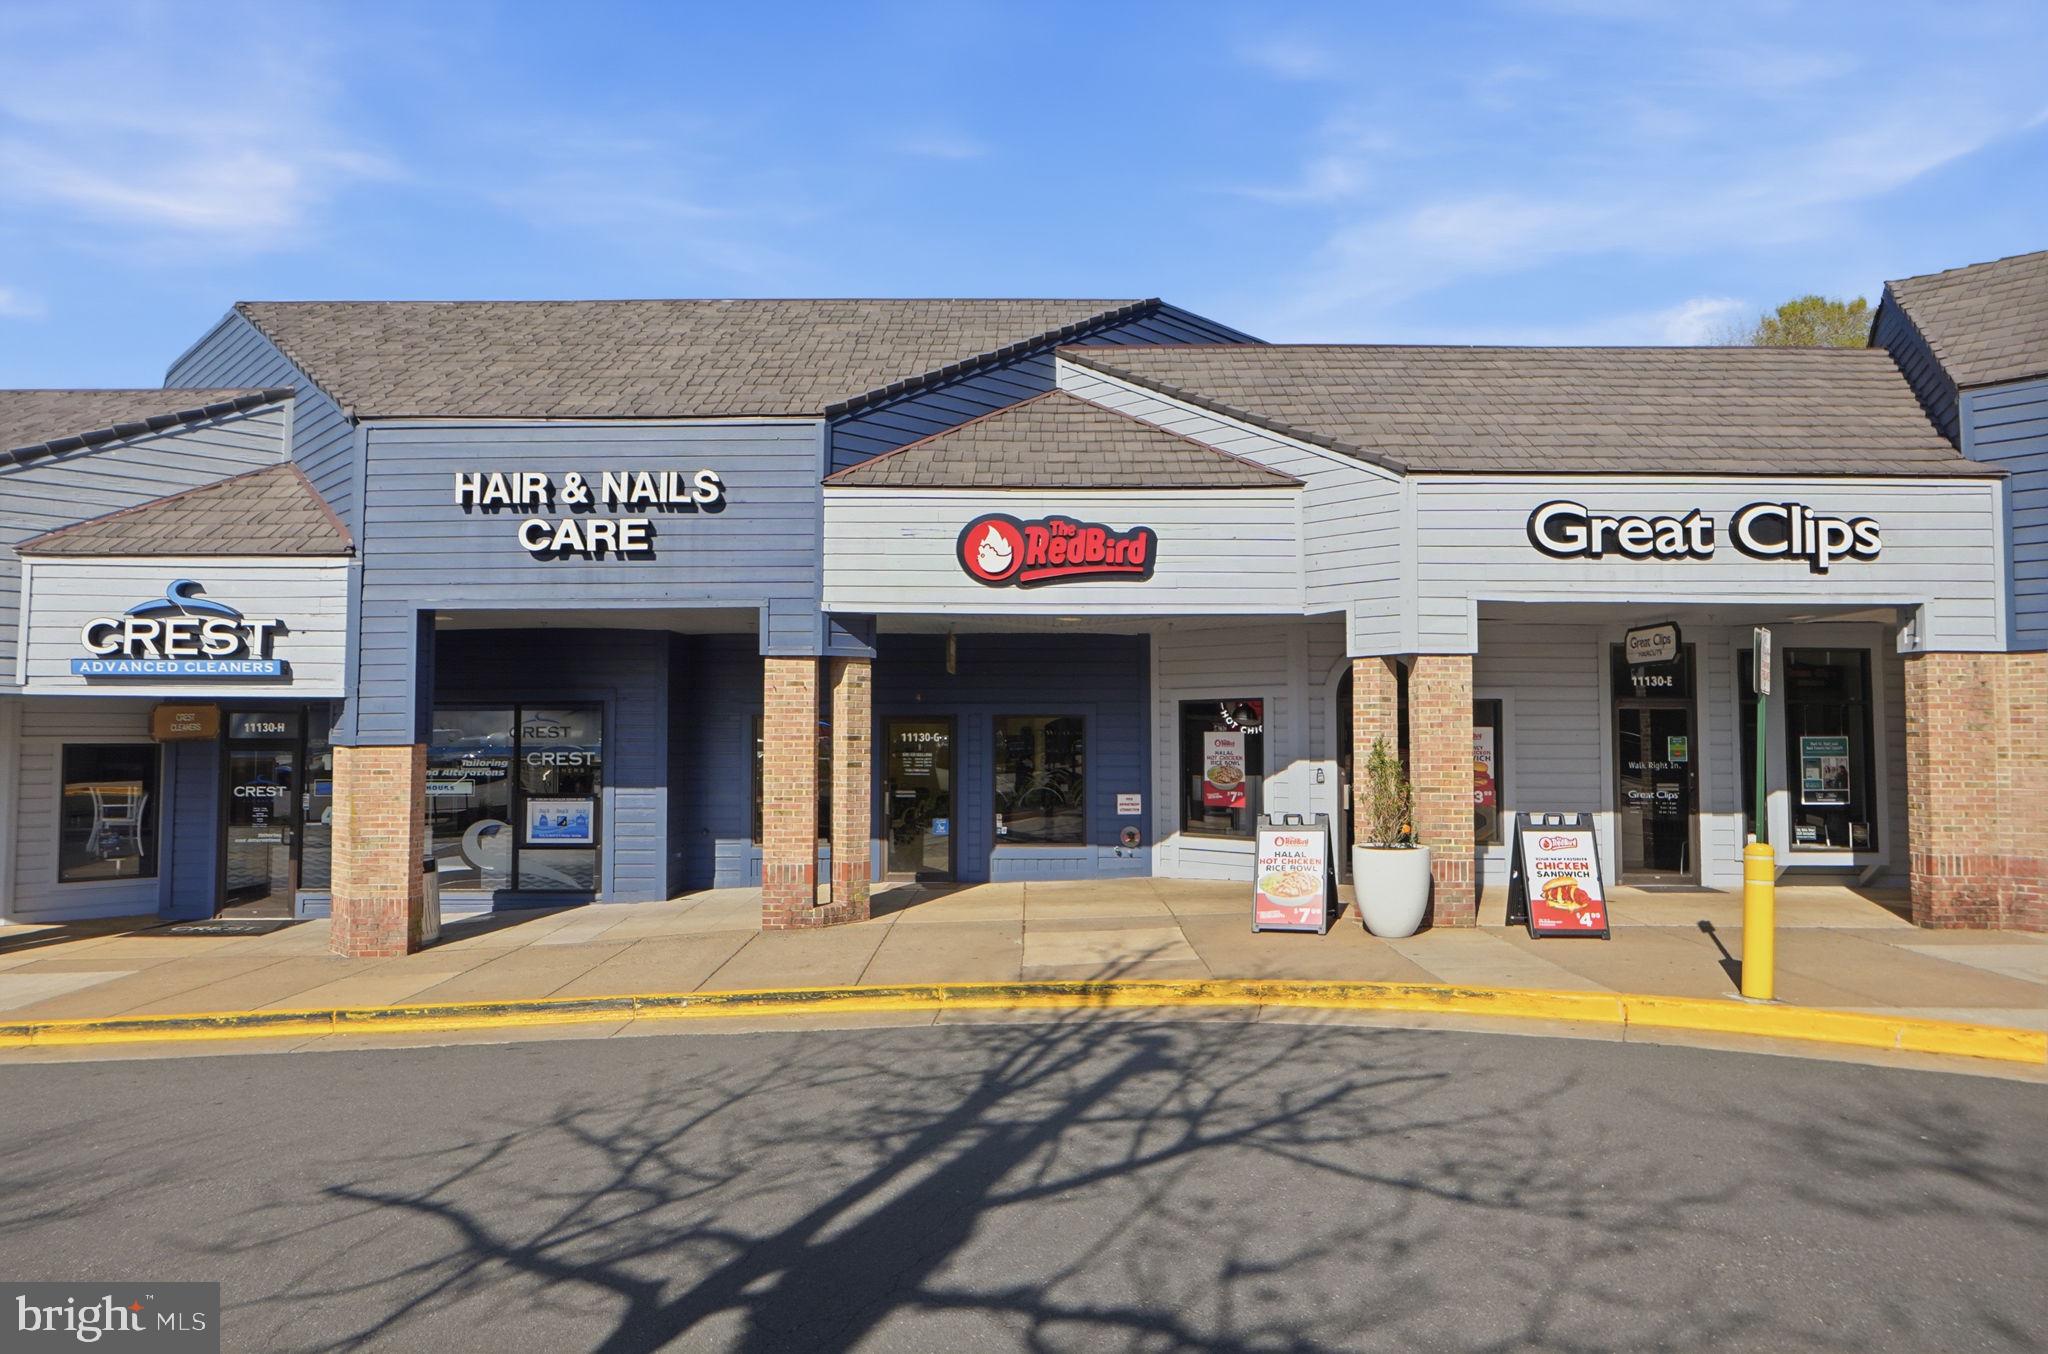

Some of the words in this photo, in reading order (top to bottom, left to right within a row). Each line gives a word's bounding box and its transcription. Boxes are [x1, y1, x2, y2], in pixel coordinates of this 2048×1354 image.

[455, 472, 549, 503] HAIR
[560, 472, 588, 503] &
[602, 469, 720, 503] NAILS
[518, 518, 649, 551] CARE
[1050, 520, 1076, 537] The
[1533, 502, 1714, 554] Great
[1738, 504, 1882, 568] Clips
[1025, 526, 1148, 567] RedBird
[80, 617, 276, 656] CREST
[1630, 636, 1651, 649] Great
[79, 661, 178, 673] ADVANCED
[184, 660, 274, 673] CLEANERS
[1631, 676, 1673, 687] 11130-E
[244, 722, 285, 733] 11130-H
[509, 726, 572, 739] CREST
[901, 732, 940, 742] 11130-G
[462, 759, 509, 768] Tailoring
[526, 751, 596, 766] CREST
[426, 769, 439, 777] nd
[441, 768, 505, 777] Alterations
[1628, 761, 1647, 769] Walk
[1648, 761, 1668, 771] Right
[233, 785, 288, 797] CREST
[1627, 789, 1655, 799] Great
[1656, 789, 1679, 801] Clips
[1535, 862, 1589, 870] CHICKEN
